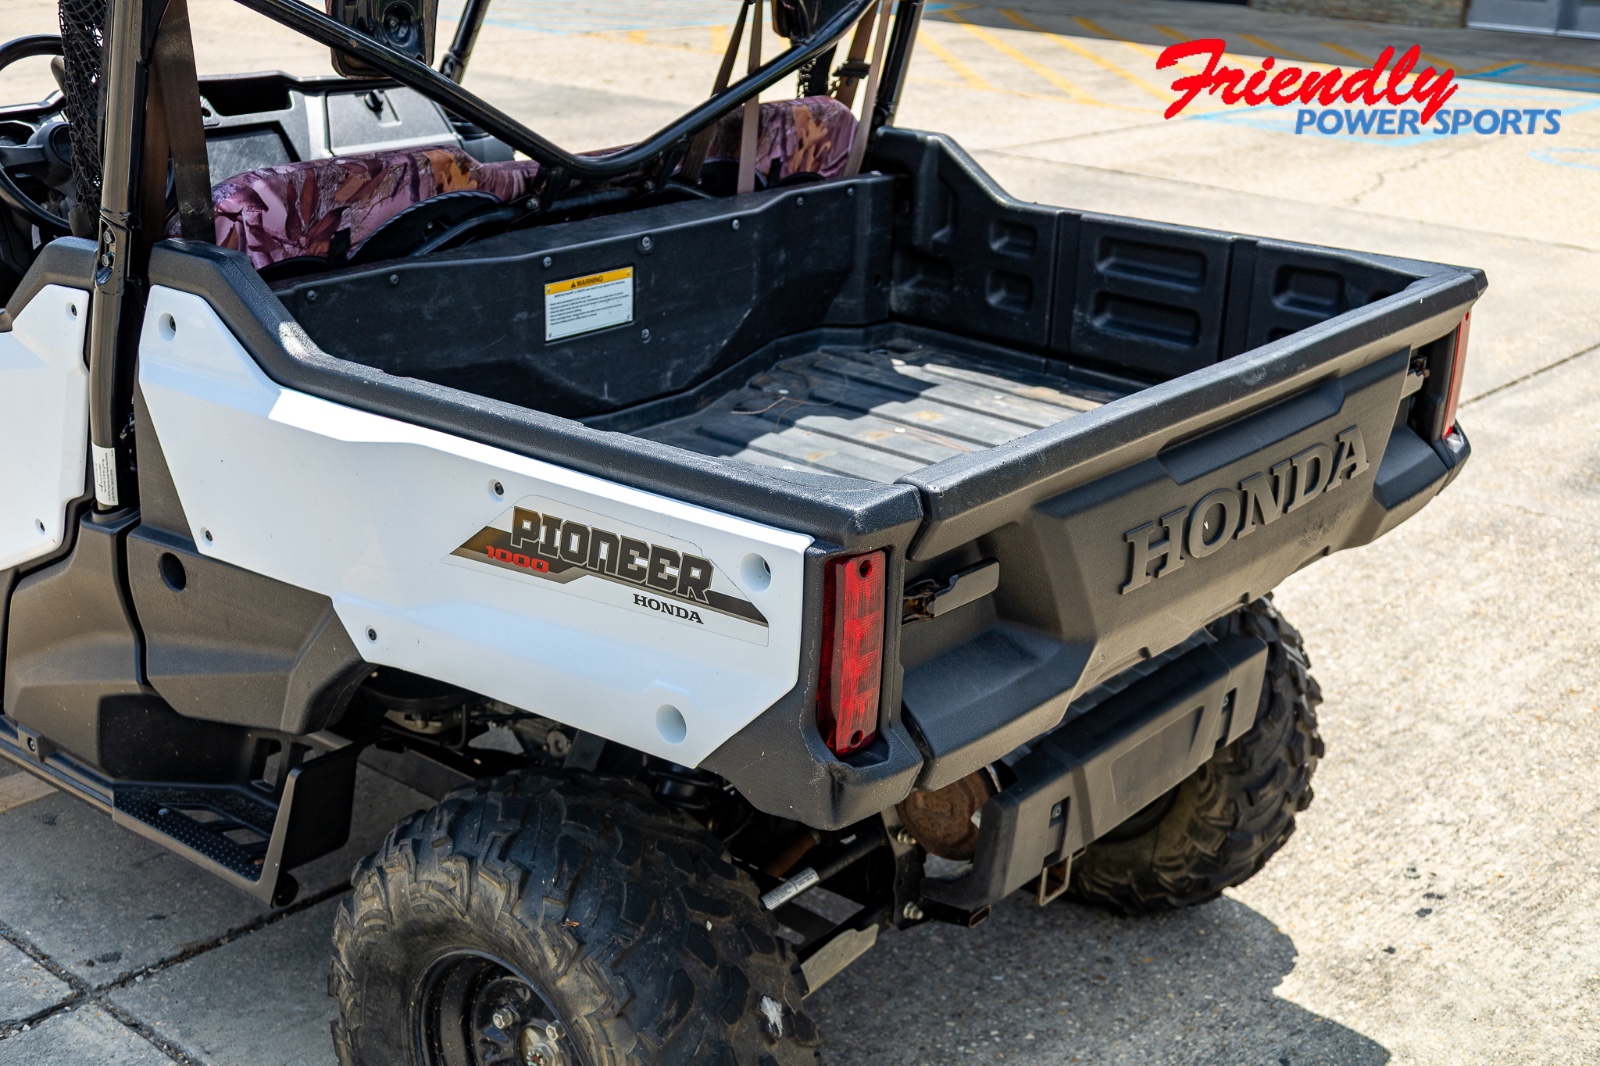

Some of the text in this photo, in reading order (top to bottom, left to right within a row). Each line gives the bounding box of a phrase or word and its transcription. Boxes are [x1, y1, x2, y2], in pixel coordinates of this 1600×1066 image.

[577, 275, 603, 287] WARNING
[1119, 424, 1370, 595] HONDA
[485, 545, 549, 573] 1000
[510, 506, 714, 604] PIONEER
[633, 593, 704, 625] HONDA
